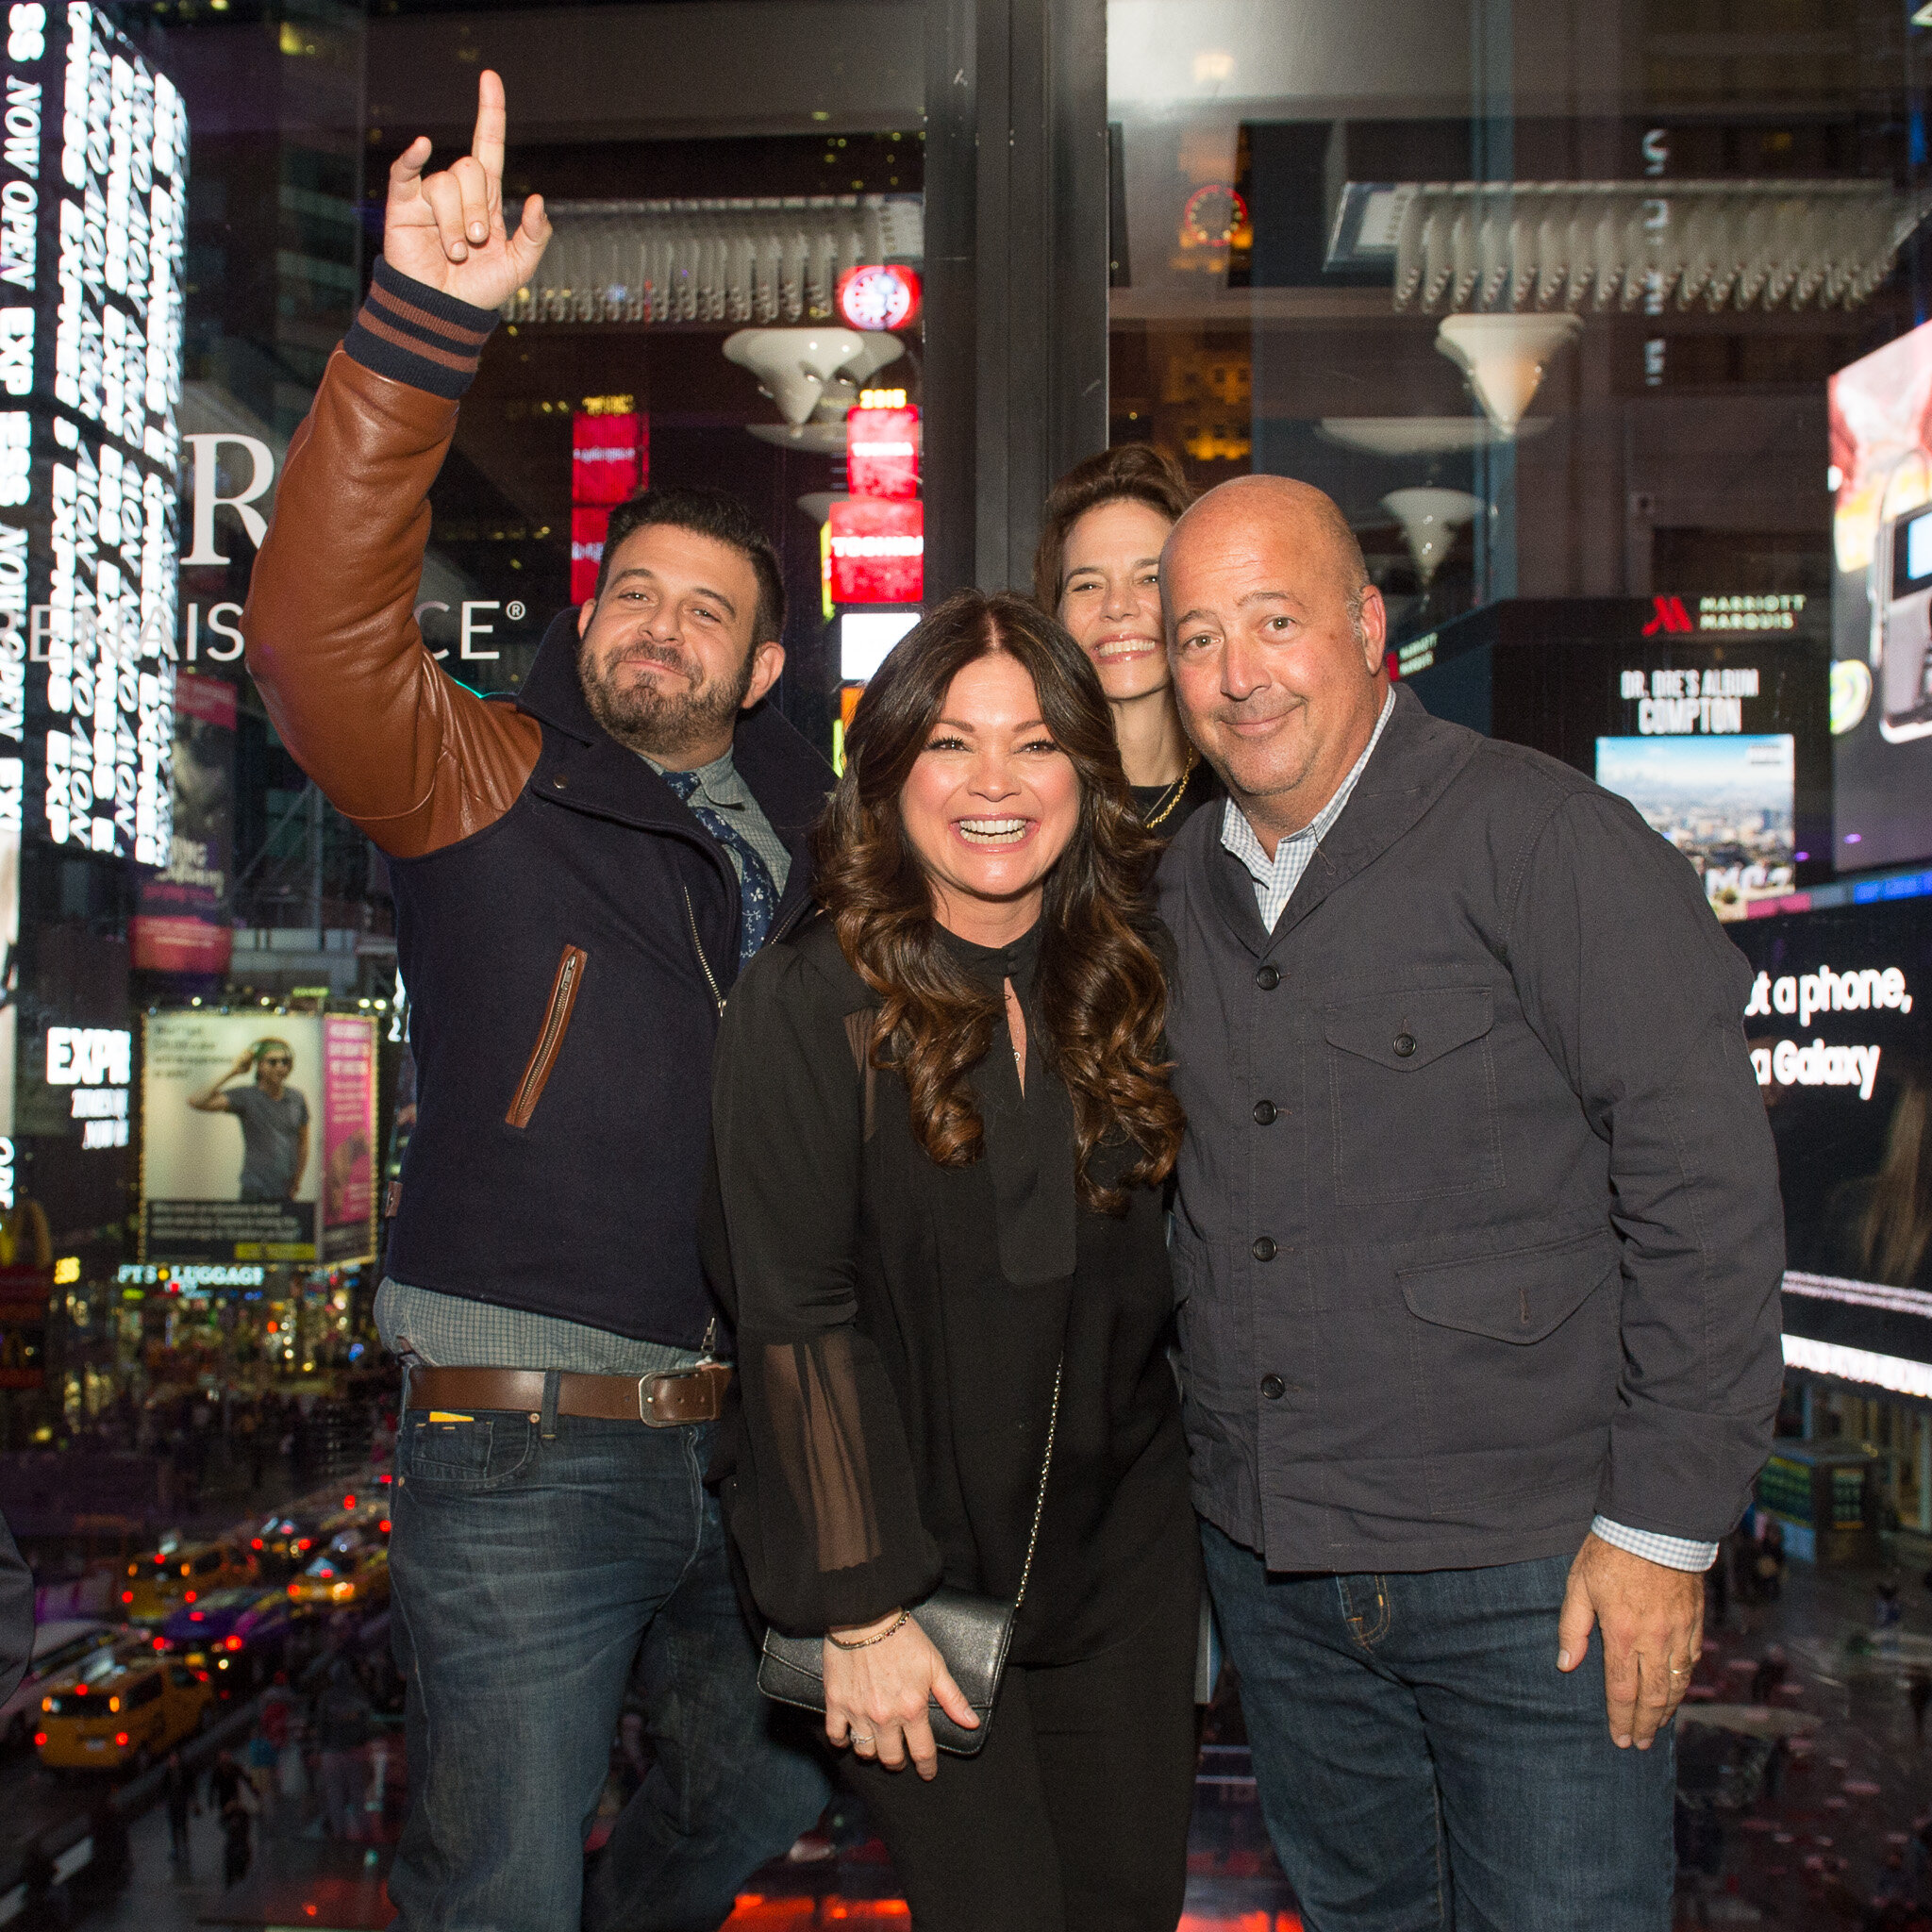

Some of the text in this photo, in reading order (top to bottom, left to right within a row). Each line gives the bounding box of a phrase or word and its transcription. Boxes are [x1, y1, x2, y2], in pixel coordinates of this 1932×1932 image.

[4, 75, 42, 180] NOW
[0, 180, 38, 291] OPEN
[179, 433, 275, 565] R
[1700, 593, 1806, 612] MARRIOTT
[1700, 612, 1793, 630] MARQUIS
[1701, 668, 1759, 697] ALBUM
[1639, 696, 1741, 735] COMPTON
[1774, 976, 1797, 1014] a
[1800, 965, 1913, 1027] phone,
[1774, 1039, 1881, 1101] Galaxy
